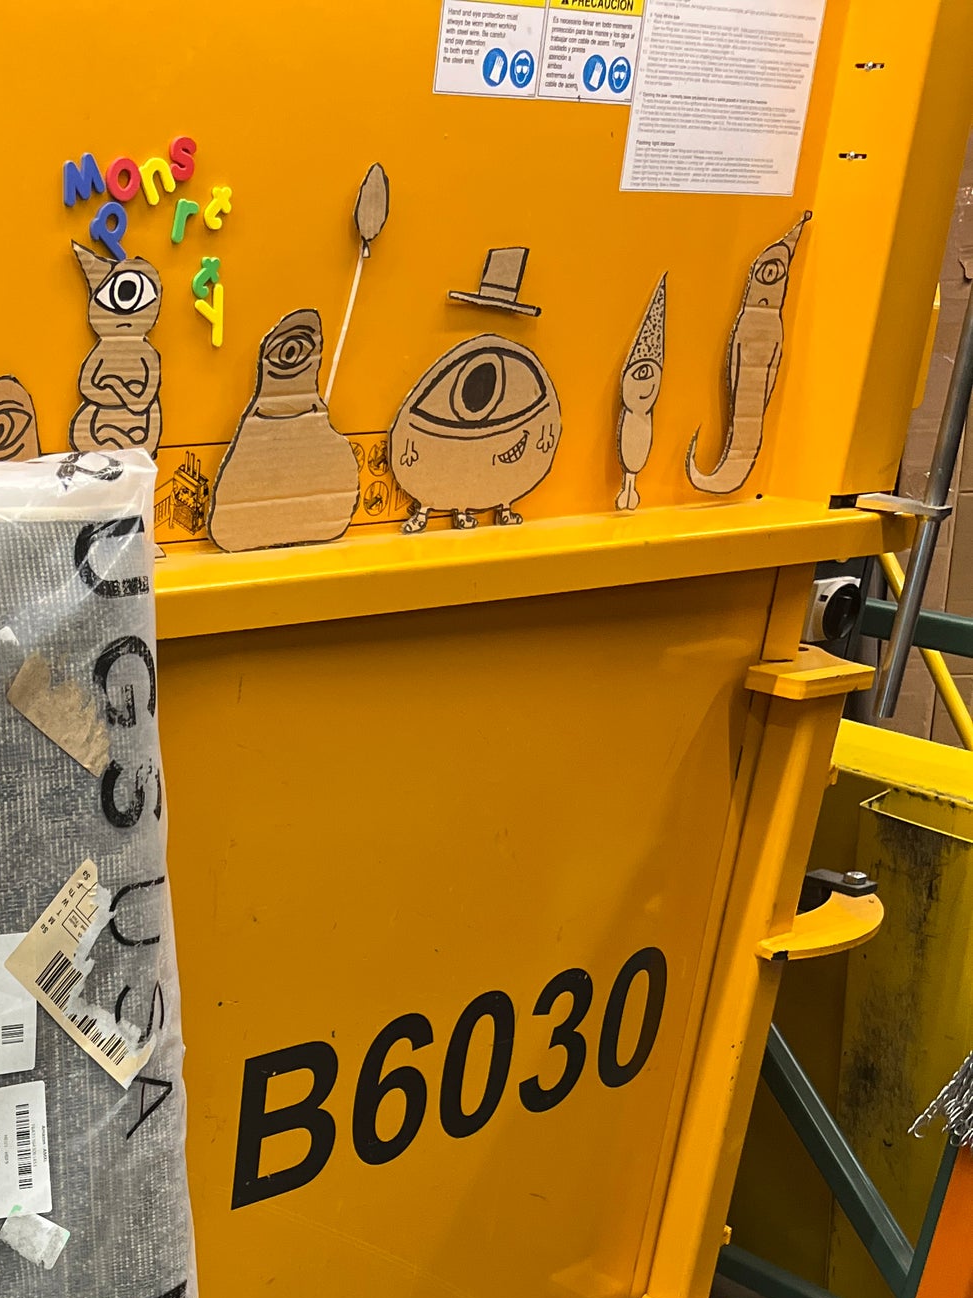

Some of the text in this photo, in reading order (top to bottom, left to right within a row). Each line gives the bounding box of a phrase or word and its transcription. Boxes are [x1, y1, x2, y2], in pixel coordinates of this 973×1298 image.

[448, 7, 462, 16] Hand
[462, 9, 472, 17] and
[482, 11, 506, 19] protection
[447, 18, 464, 26] always
[498, 22, 517, 31] working
[560, 17, 581, 25] necesario
[582, 19, 595, 27] llevar
[612, 22, 633, 30] momento
[575, 28, 586, 36] para
[455, 38, 464, 46] pay
[465, 38, 486, 47] attention
[612, 40, 625, 48] Tenga
[549, 44, 567, 52] cuidado
[230, 946, 668, 1211] B6030
